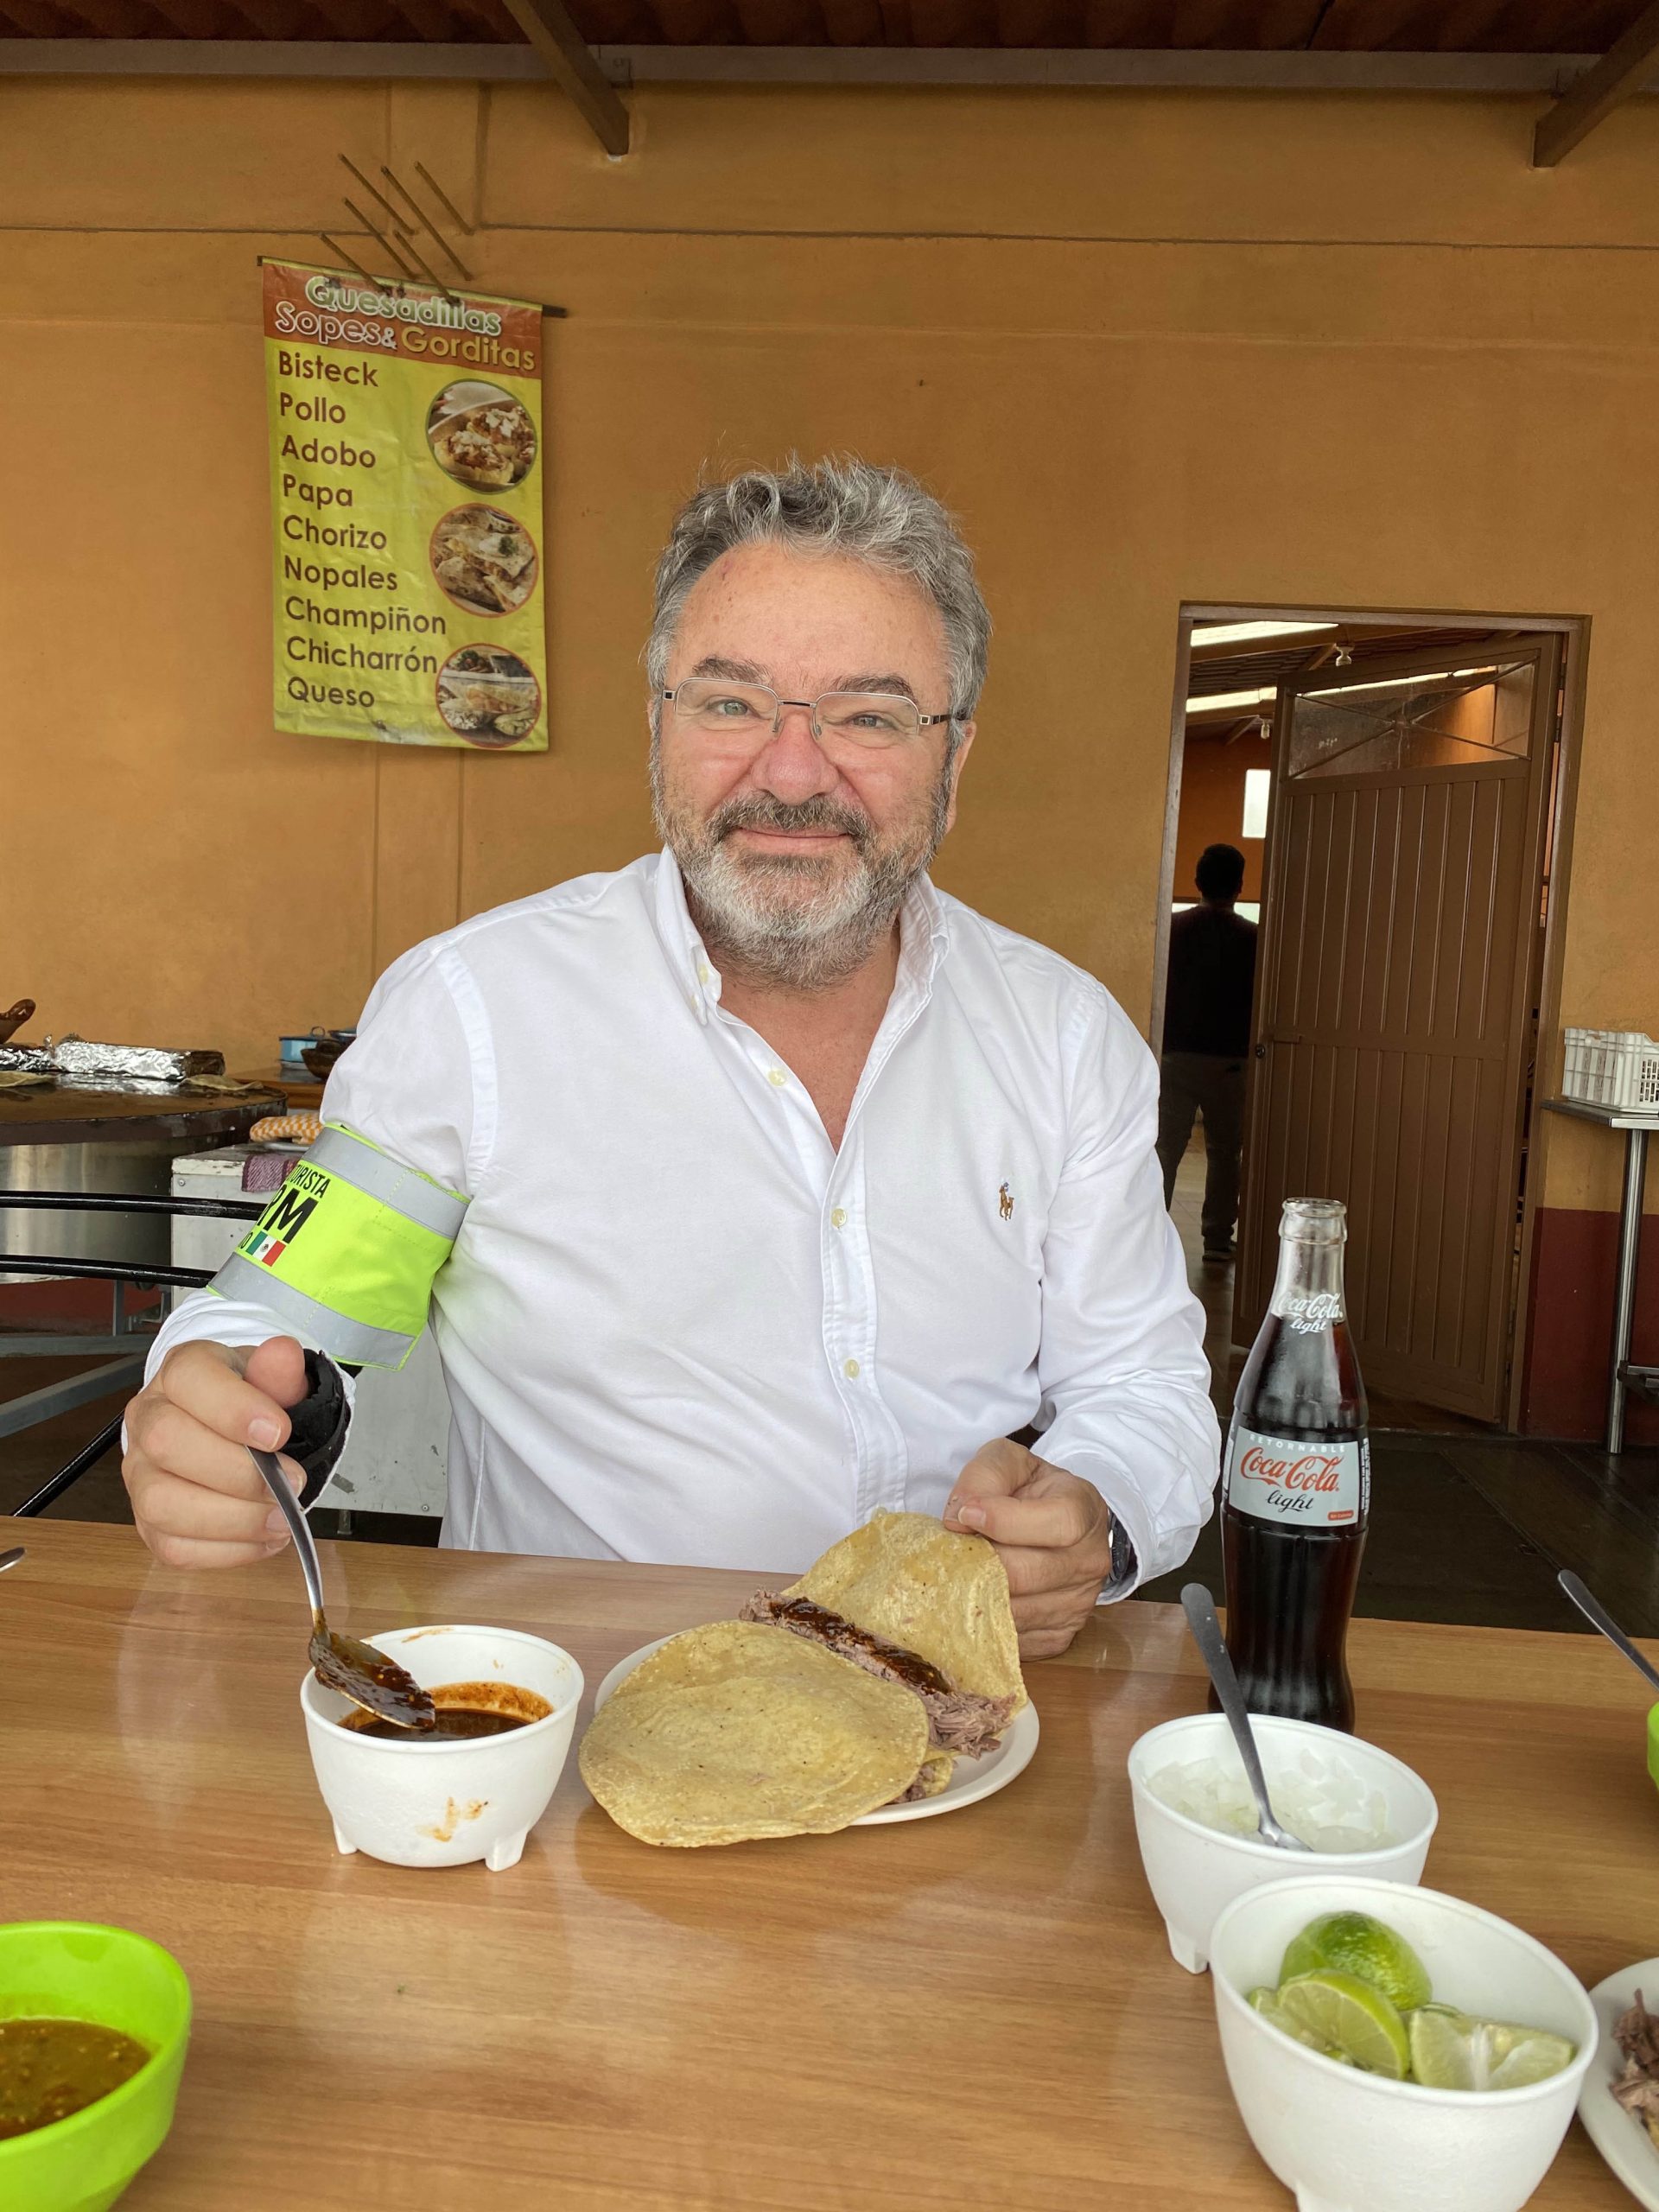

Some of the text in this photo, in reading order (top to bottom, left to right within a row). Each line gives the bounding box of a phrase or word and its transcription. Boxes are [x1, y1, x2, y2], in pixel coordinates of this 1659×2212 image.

[304, 276, 502, 336] Quesadillas
[401, 326, 536, 371] Gorditas
[278, 350, 378, 387] Bisteck
[280, 391, 346, 423] Pollo
[282, 435, 376, 468] Adobo
[283, 474, 353, 510] Papa
[283, 514, 387, 550] Chorizo
[284, 555, 398, 591] Nopales
[285, 595, 447, 635] Champiñon
[287, 635, 437, 674] Chicharrón
[288, 676, 375, 708] Queso
[1289, 1318, 1327, 1335] light
[1249, 1433, 1347, 1453] RETORNABLE
[1240, 1446, 1344, 1492] Coca-Cola
[1266, 1490, 1314, 1513] light
